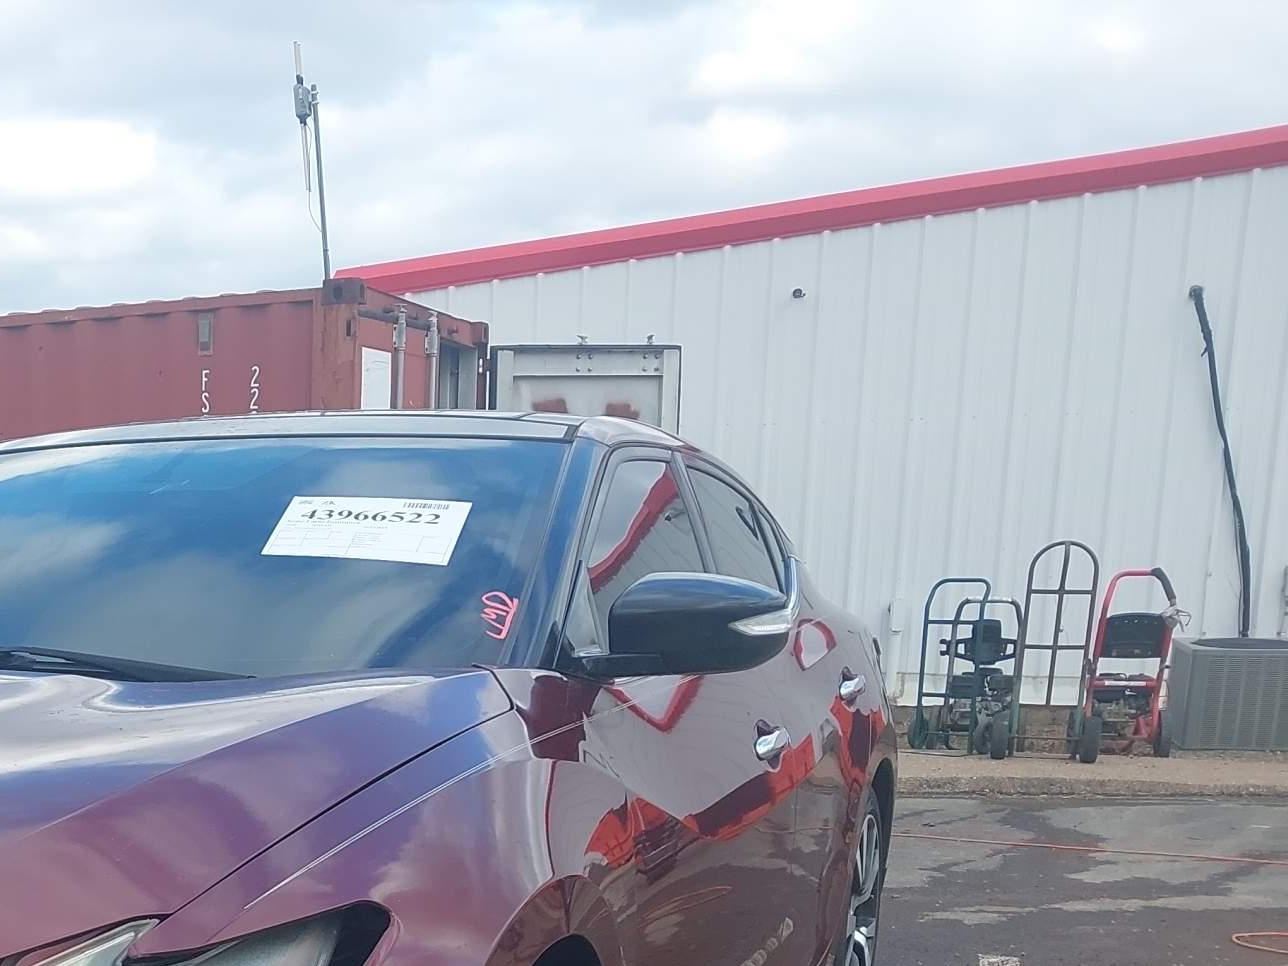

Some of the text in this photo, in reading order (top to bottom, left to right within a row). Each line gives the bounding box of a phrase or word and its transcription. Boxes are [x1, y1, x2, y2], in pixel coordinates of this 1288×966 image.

[201, 369, 210, 416] FS
[249, 365, 260, 413] 22
[301, 508, 441, 524] 43966522
